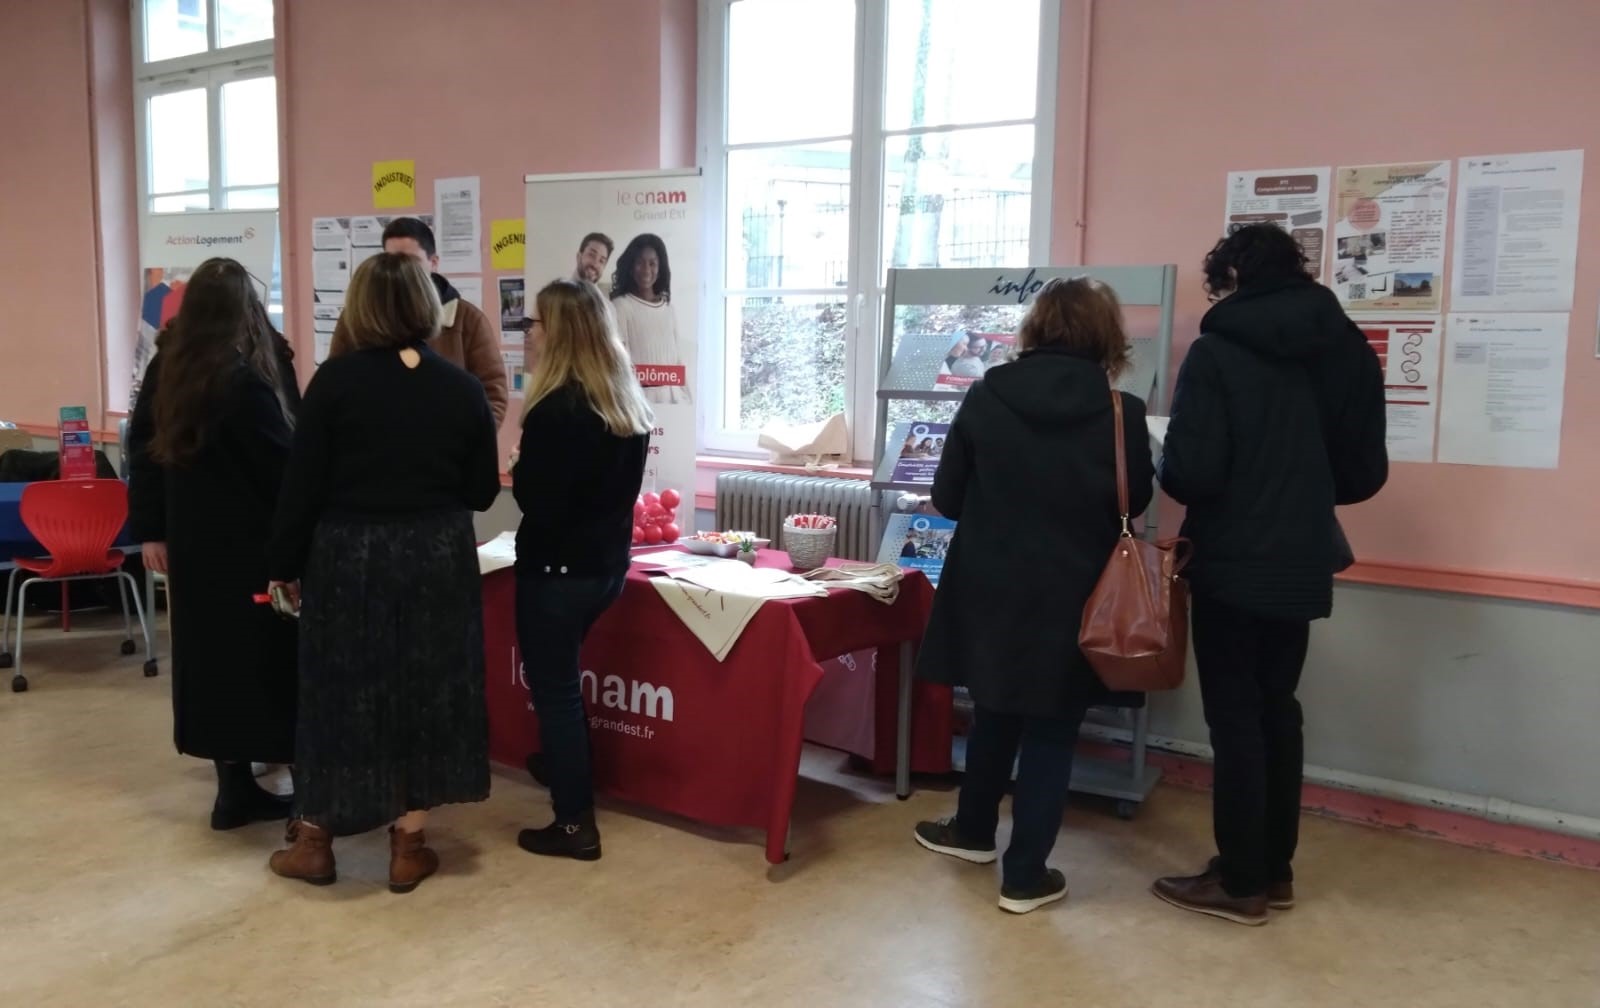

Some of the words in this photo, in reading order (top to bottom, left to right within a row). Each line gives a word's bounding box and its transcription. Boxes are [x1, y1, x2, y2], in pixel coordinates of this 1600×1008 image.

[374, 171, 414, 192] INDUSTRIEL
[617, 190, 632, 206] le
[635, 190, 687, 205] cnam
[166, 234, 243, 247] ActionLogement
[988, 268, 1044, 304] info
[636, 367, 681, 384] plôme,
[580, 670, 674, 722] nam
